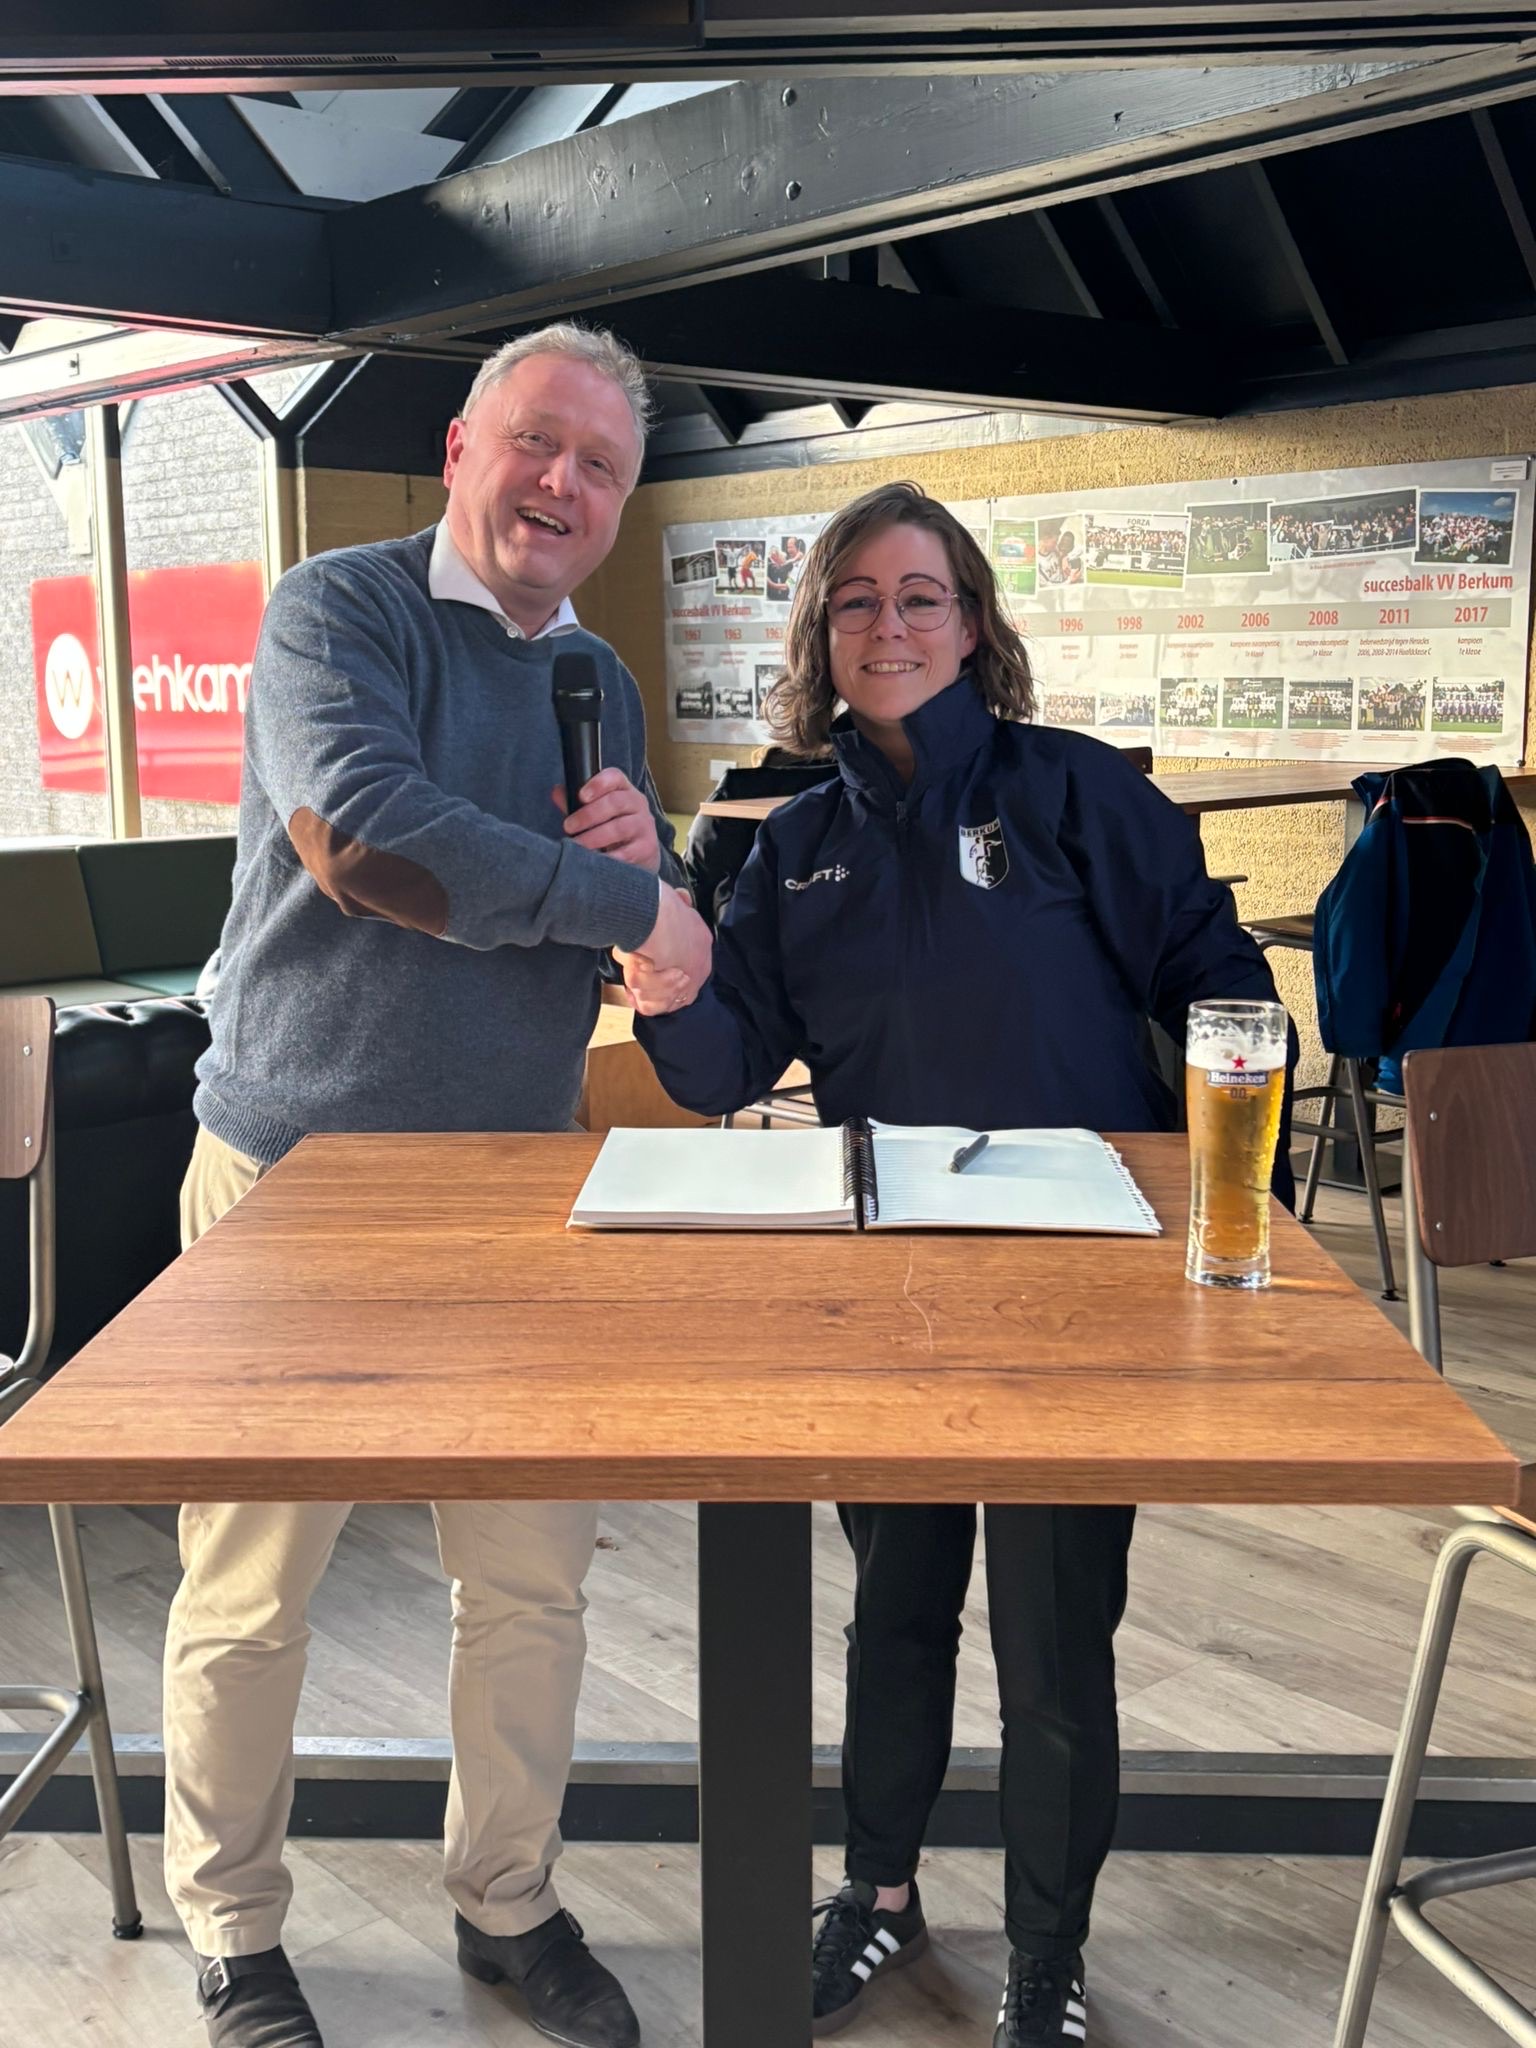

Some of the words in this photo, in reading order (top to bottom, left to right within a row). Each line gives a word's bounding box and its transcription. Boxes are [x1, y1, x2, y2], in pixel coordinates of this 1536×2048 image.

[1127, 518, 1150, 526] FORZA
[1363, 574, 1434, 593] succesbalk
[1437, 573, 1456, 590] VV
[1458, 571, 1514, 590] Berkum
[1177, 614, 1204, 629] 2002
[1241, 612, 1270, 627] 2006
[1308, 610, 1338, 626] 2008
[1379, 608, 1410, 624] 2011
[1454, 606, 1488, 623] 2017
[1059, 618, 1084, 632] 1996
[1117, 616, 1143, 631] 1998
[96, 653, 253, 713] ehkam
[1210, 1071, 1266, 1084] Heineken
